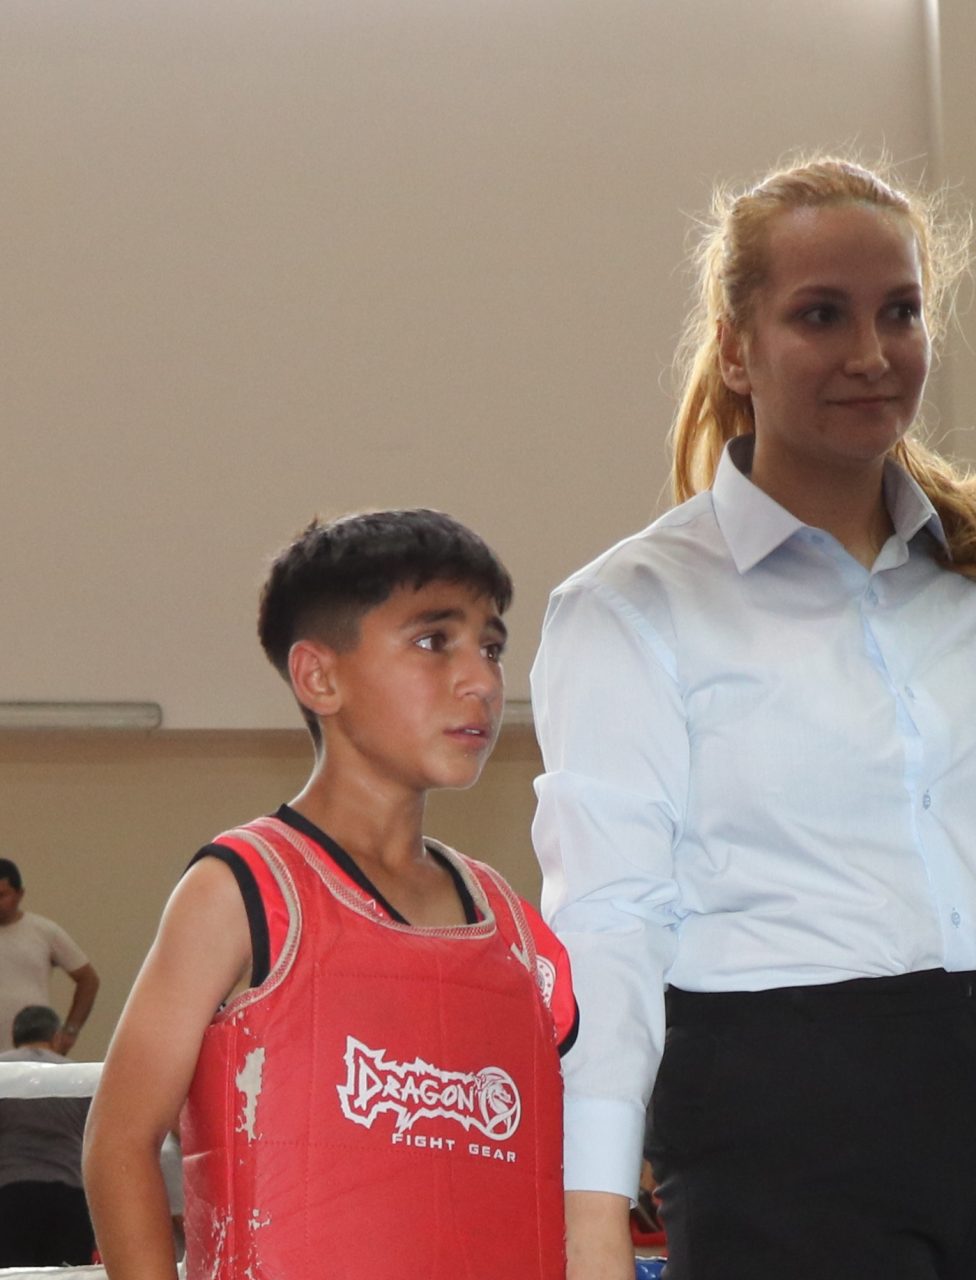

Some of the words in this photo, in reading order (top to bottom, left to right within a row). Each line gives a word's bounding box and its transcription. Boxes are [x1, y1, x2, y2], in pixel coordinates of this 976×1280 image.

[352, 1055, 475, 1113] DRAGON
[391, 1133, 456, 1151] FIGHT
[468, 1143, 517, 1163] GEAR
